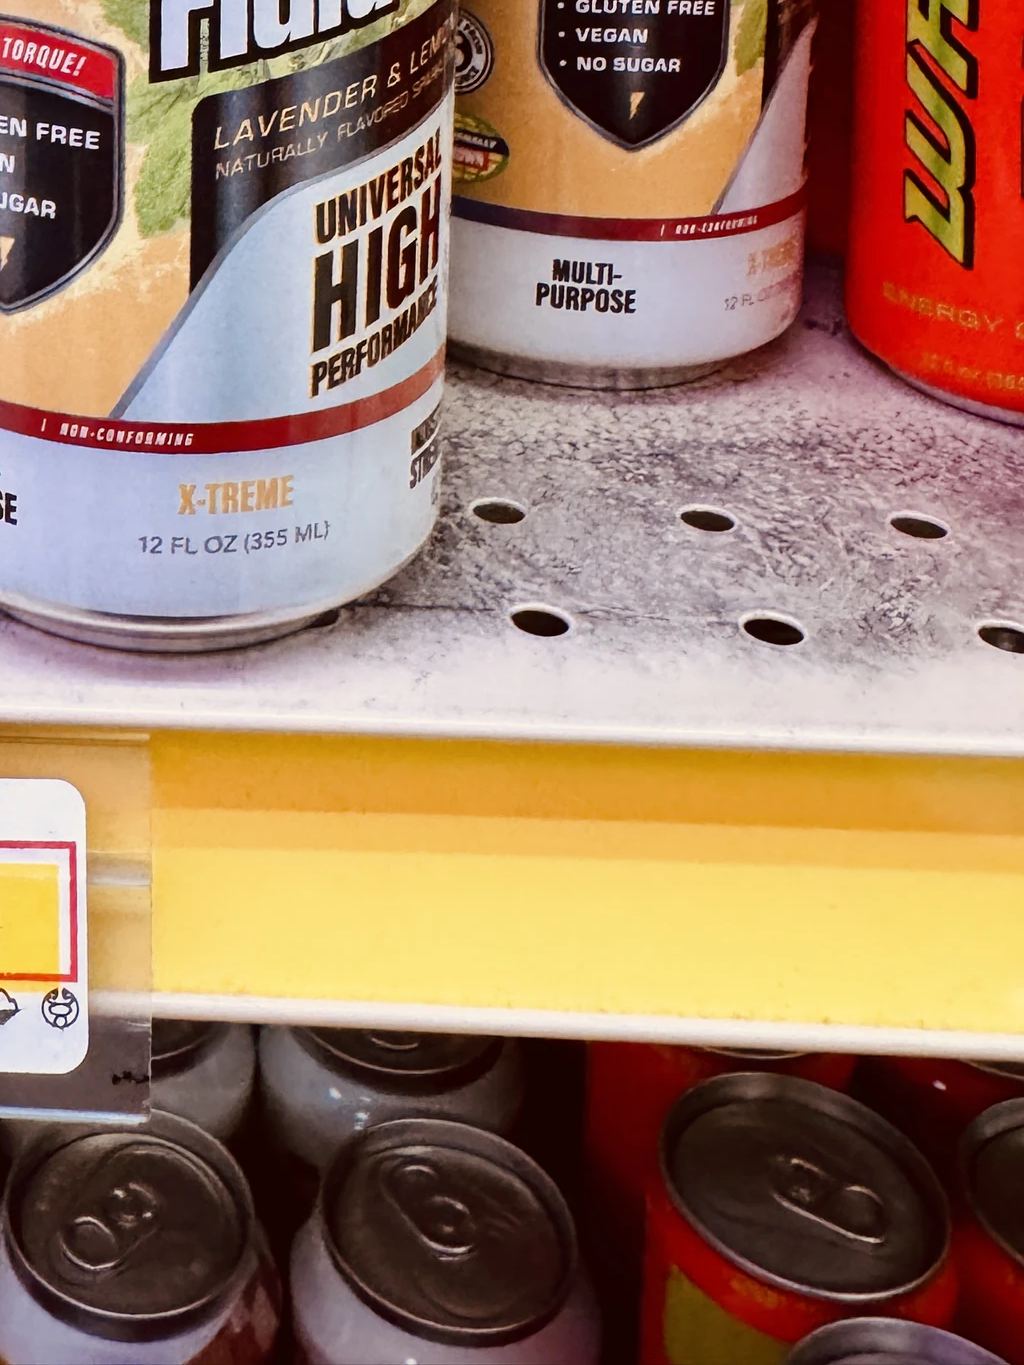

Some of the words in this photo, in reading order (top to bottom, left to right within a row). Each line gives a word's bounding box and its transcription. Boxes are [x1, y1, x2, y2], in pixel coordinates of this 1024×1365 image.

[666, 0, 716, 16] FREE
[576, 27, 648, 44] VEGAN
[2, 36, 87, 77] TORQUE!
[576, 57, 607, 72] NO
[612, 57, 681, 73] SUGAR
[213, 74, 378, 151] LAVENDER
[387, 61, 402, 88] &
[36, 122, 101, 150] FREE
[215, 130, 329, 181] NATURALLY
[314, 126, 443, 245] UNIVERSAL
[311, 170, 442, 356] HIGH
[552, 259, 623, 286] MULTI-
[535, 282, 637, 315] PURPOSE
[308, 274, 439, 400] PERFORMANCE
[59, 422, 195, 447] NON-CONFORMING
[177, 475, 294, 515] X-TREME
[139, 536, 163, 555] 12
[170, 537, 198, 556] FL
[203, 534, 239, 554] OZ
[243, 529, 288, 555] (355
[294, 519, 331, 542] ML)
